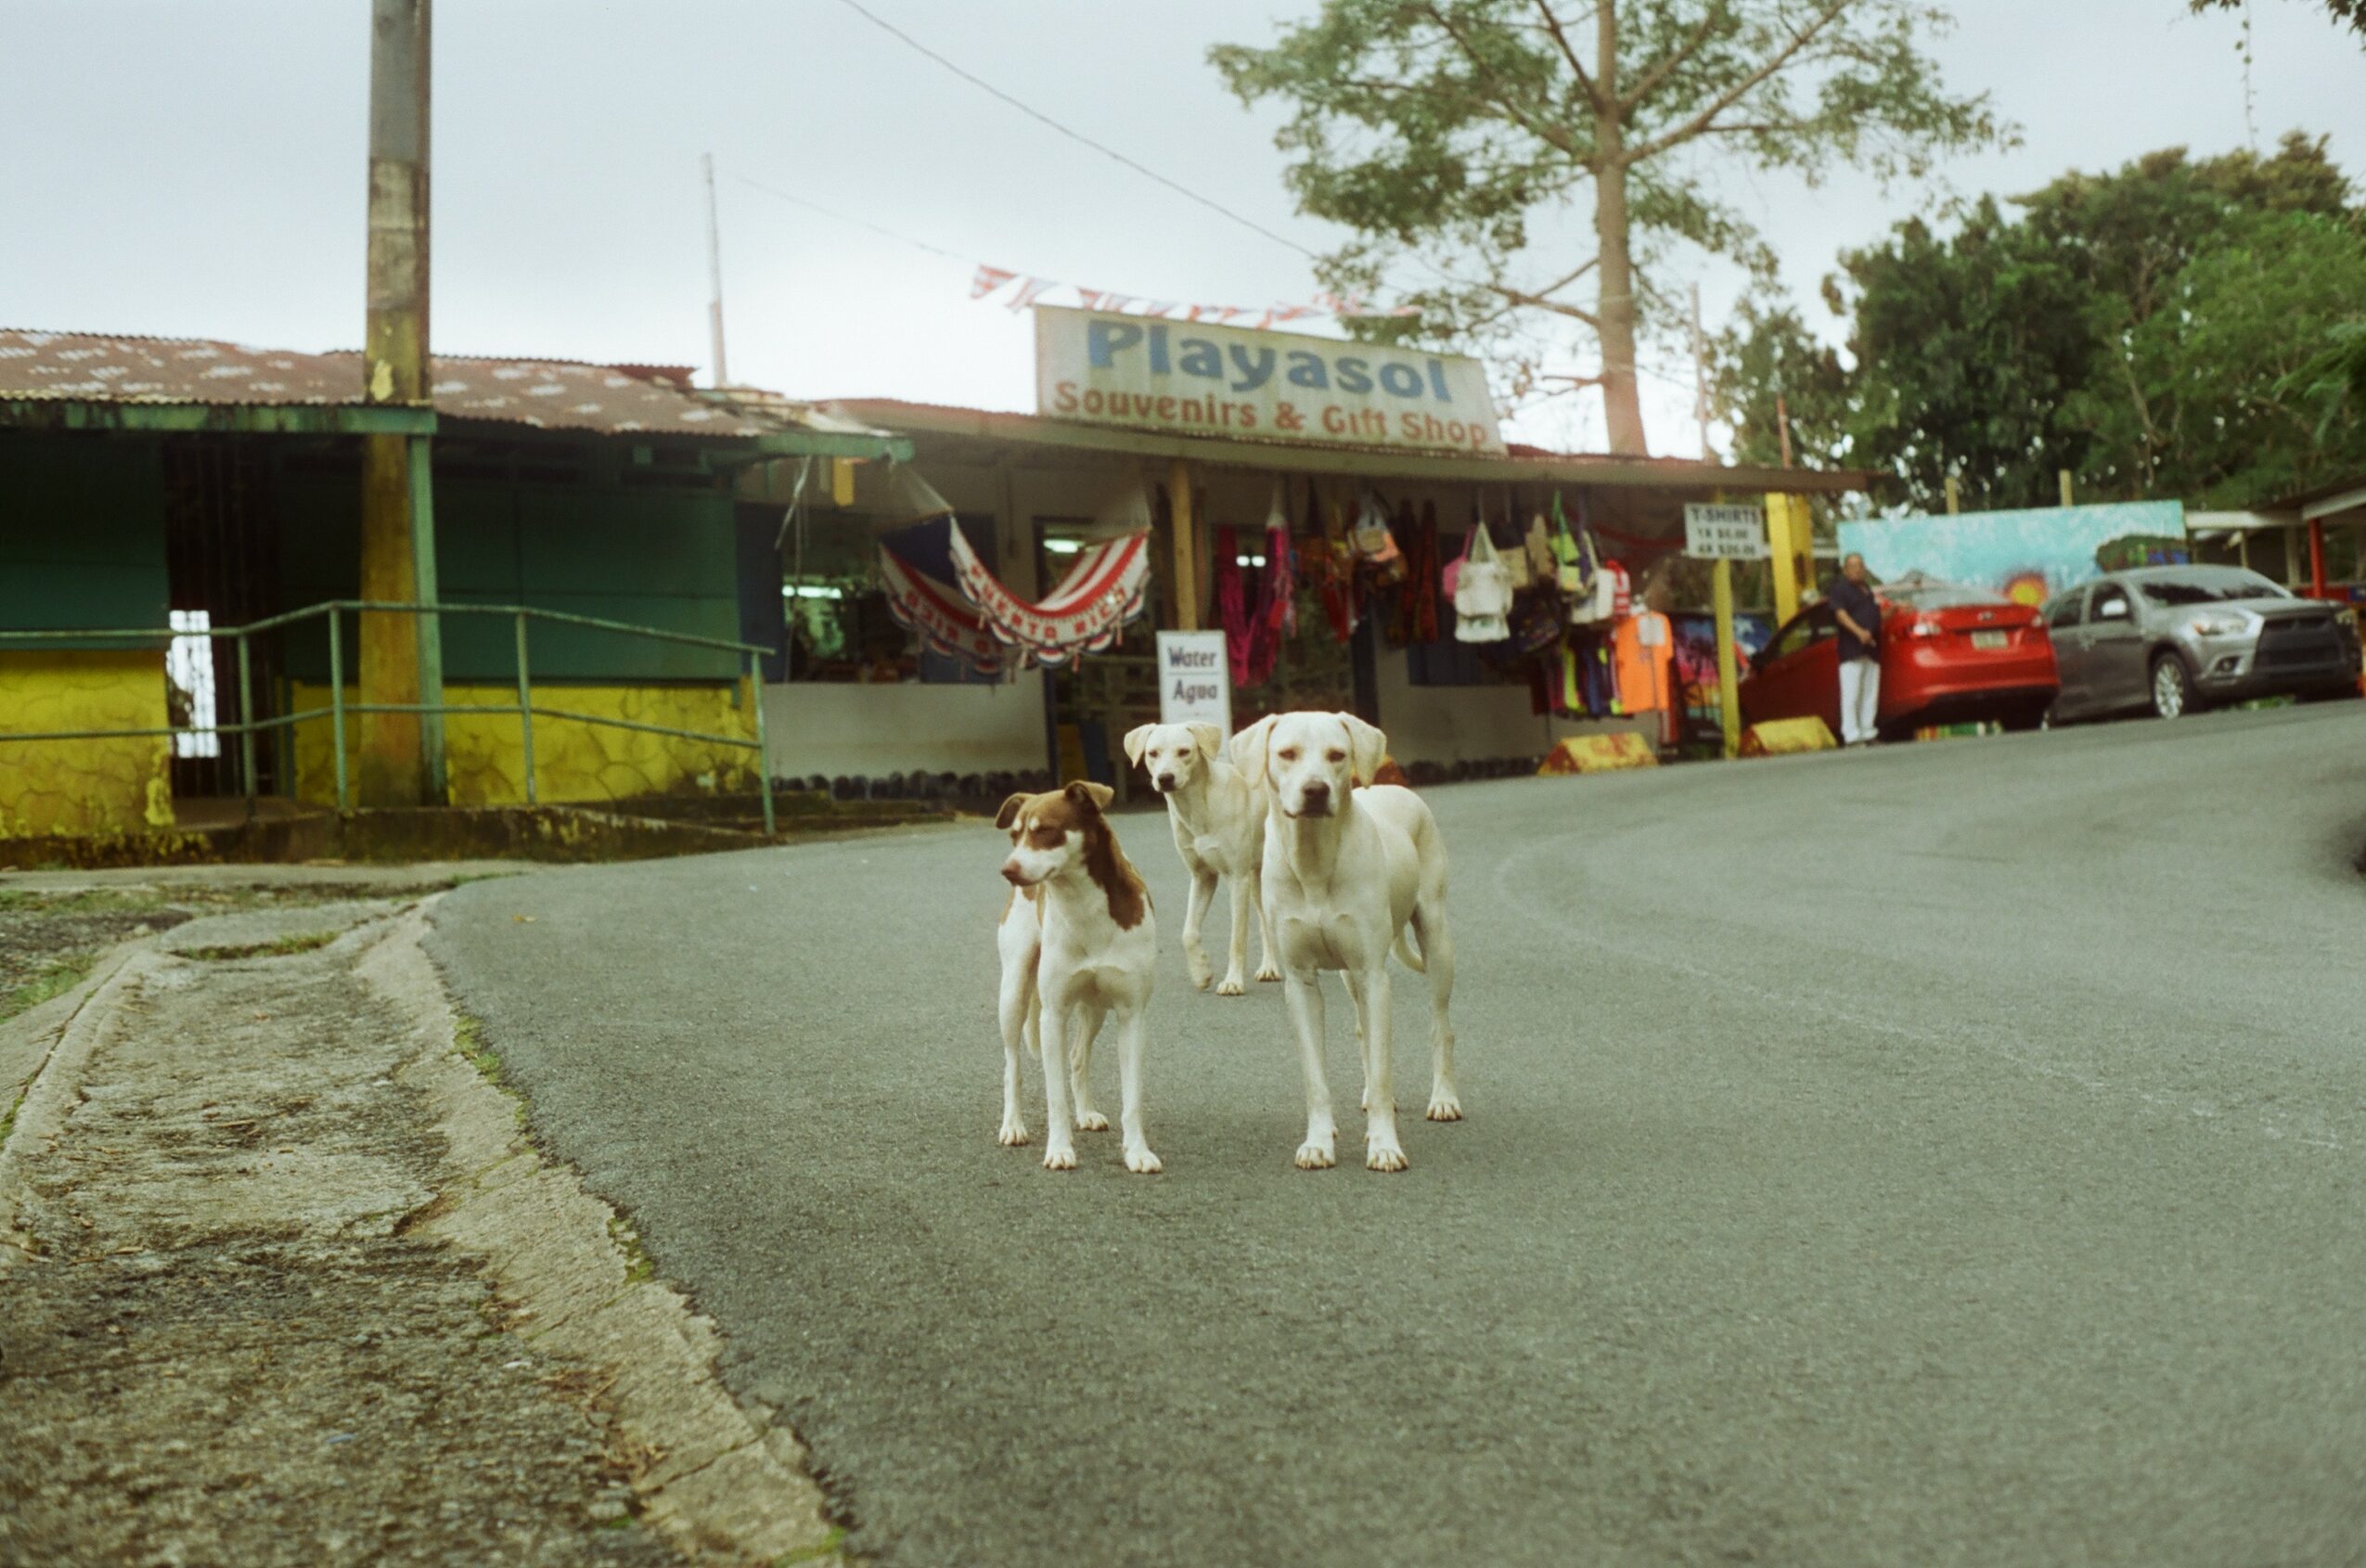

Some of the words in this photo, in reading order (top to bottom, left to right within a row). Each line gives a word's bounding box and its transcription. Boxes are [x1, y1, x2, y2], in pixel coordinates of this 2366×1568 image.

[1087, 319, 1452, 403] Playasol
[1054, 381, 1256, 428] Souvenirs
[1275, 402, 1306, 431] &
[1323, 405, 1386, 438] Gift
[1403, 414, 1490, 448] Shop
[1691, 508, 1759, 525] T-SHIRTS
[971, 563, 1058, 640] PUERTO
[1166, 646, 1217, 667] Water
[1172, 678, 1217, 704] Agua
